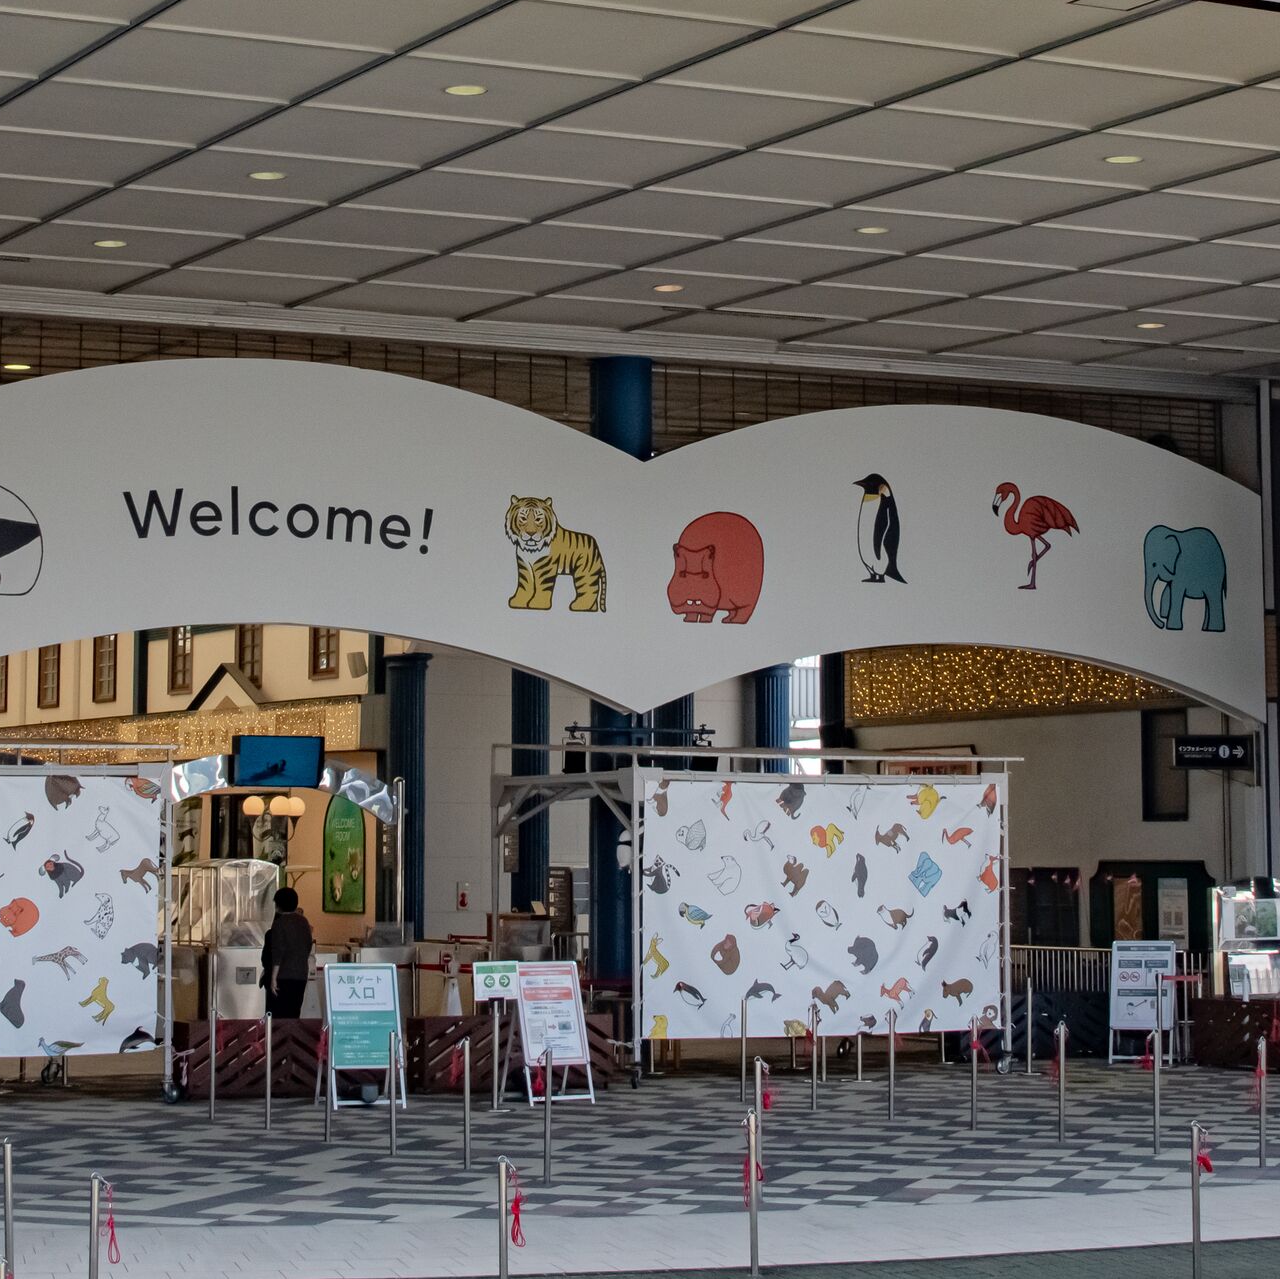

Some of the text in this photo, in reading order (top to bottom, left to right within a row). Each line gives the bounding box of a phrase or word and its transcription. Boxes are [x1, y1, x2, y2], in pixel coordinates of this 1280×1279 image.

[122, 485, 434, 555] Welcome!
[337, 975, 382, 985] 入園ゲート
[348, 986, 375, 999] 入口
